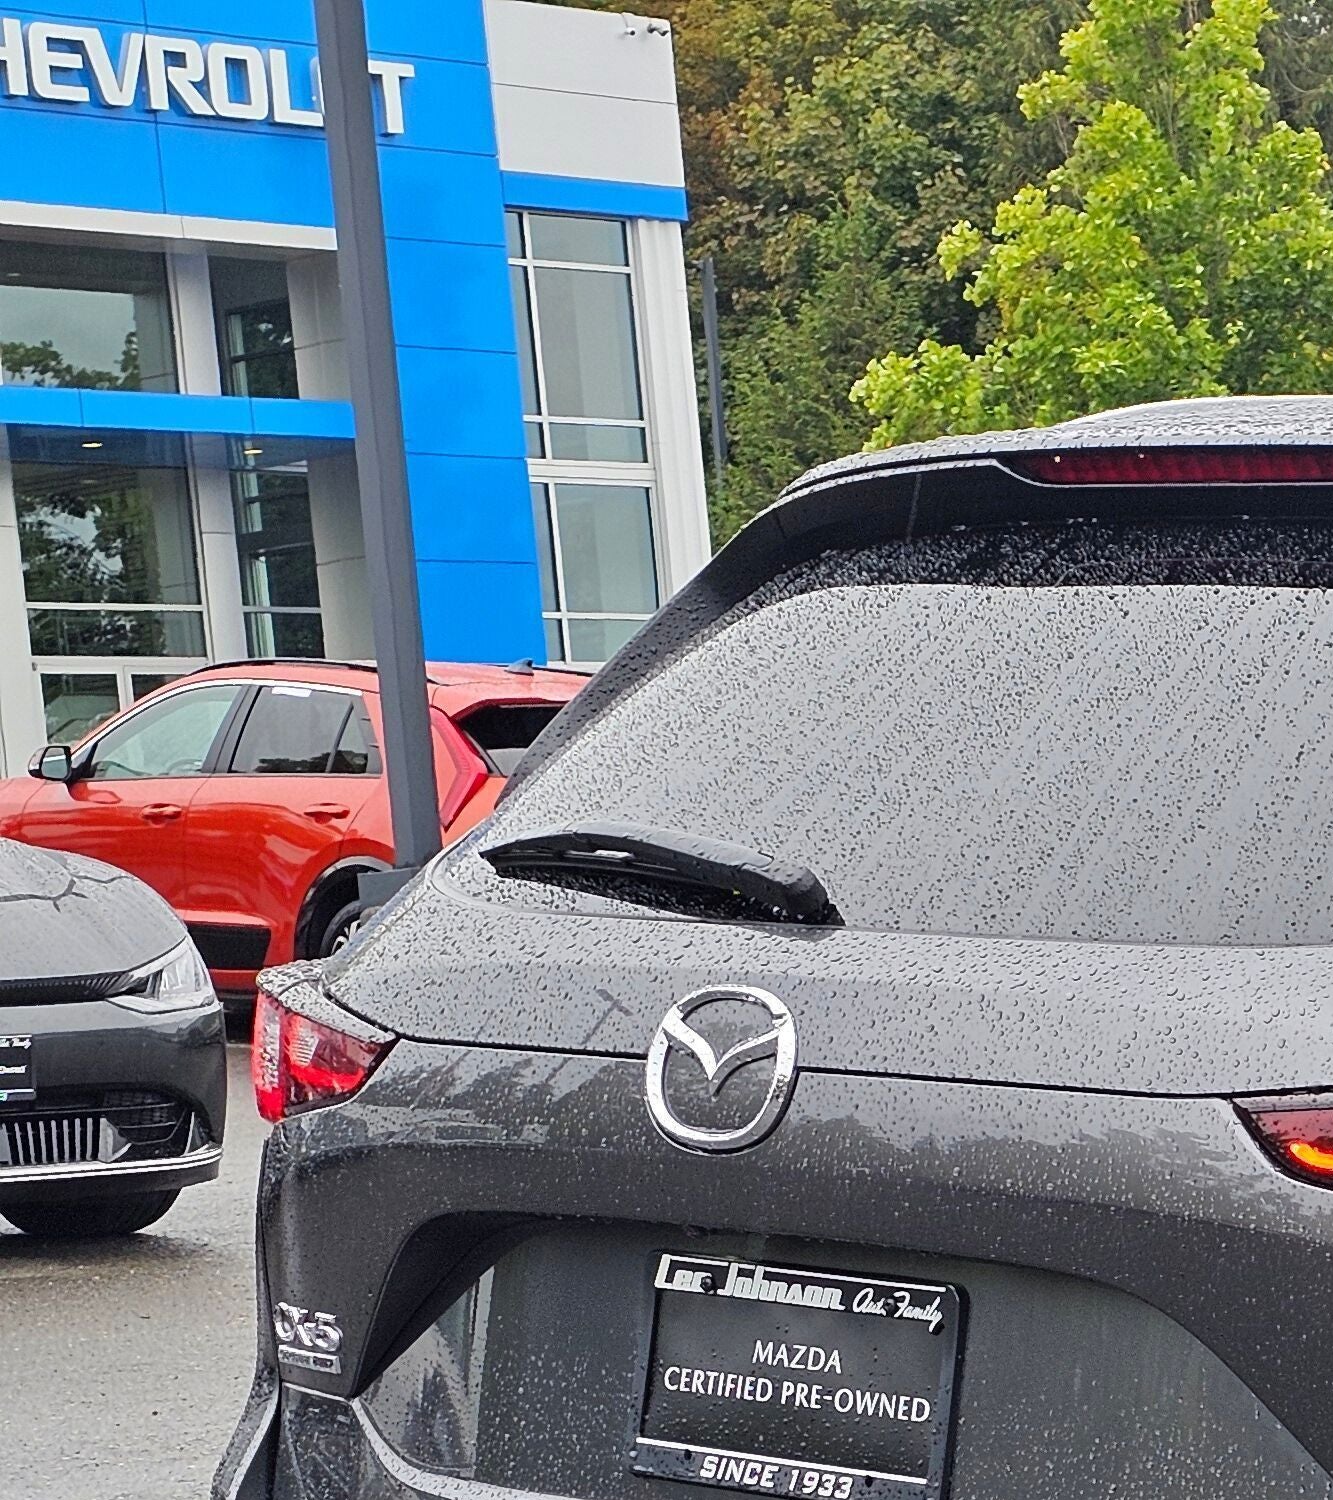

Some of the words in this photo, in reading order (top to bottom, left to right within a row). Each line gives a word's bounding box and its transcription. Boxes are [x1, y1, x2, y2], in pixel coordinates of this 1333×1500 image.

[0, 17, 415, 134] EVROLT
[716, 1262, 846, 1311] Johnson
[852, 1287, 891, 1318] Aut
[890, 1291, 943, 1334] Family
[752, 1340, 842, 1375] MAZDA
[663, 1366, 773, 1402] CERTIFIED
[781, 1380, 931, 1423] PRE-OWNED
[700, 1456, 780, 1488] SINCE
[788, 1469, 853, 1499] 1933
